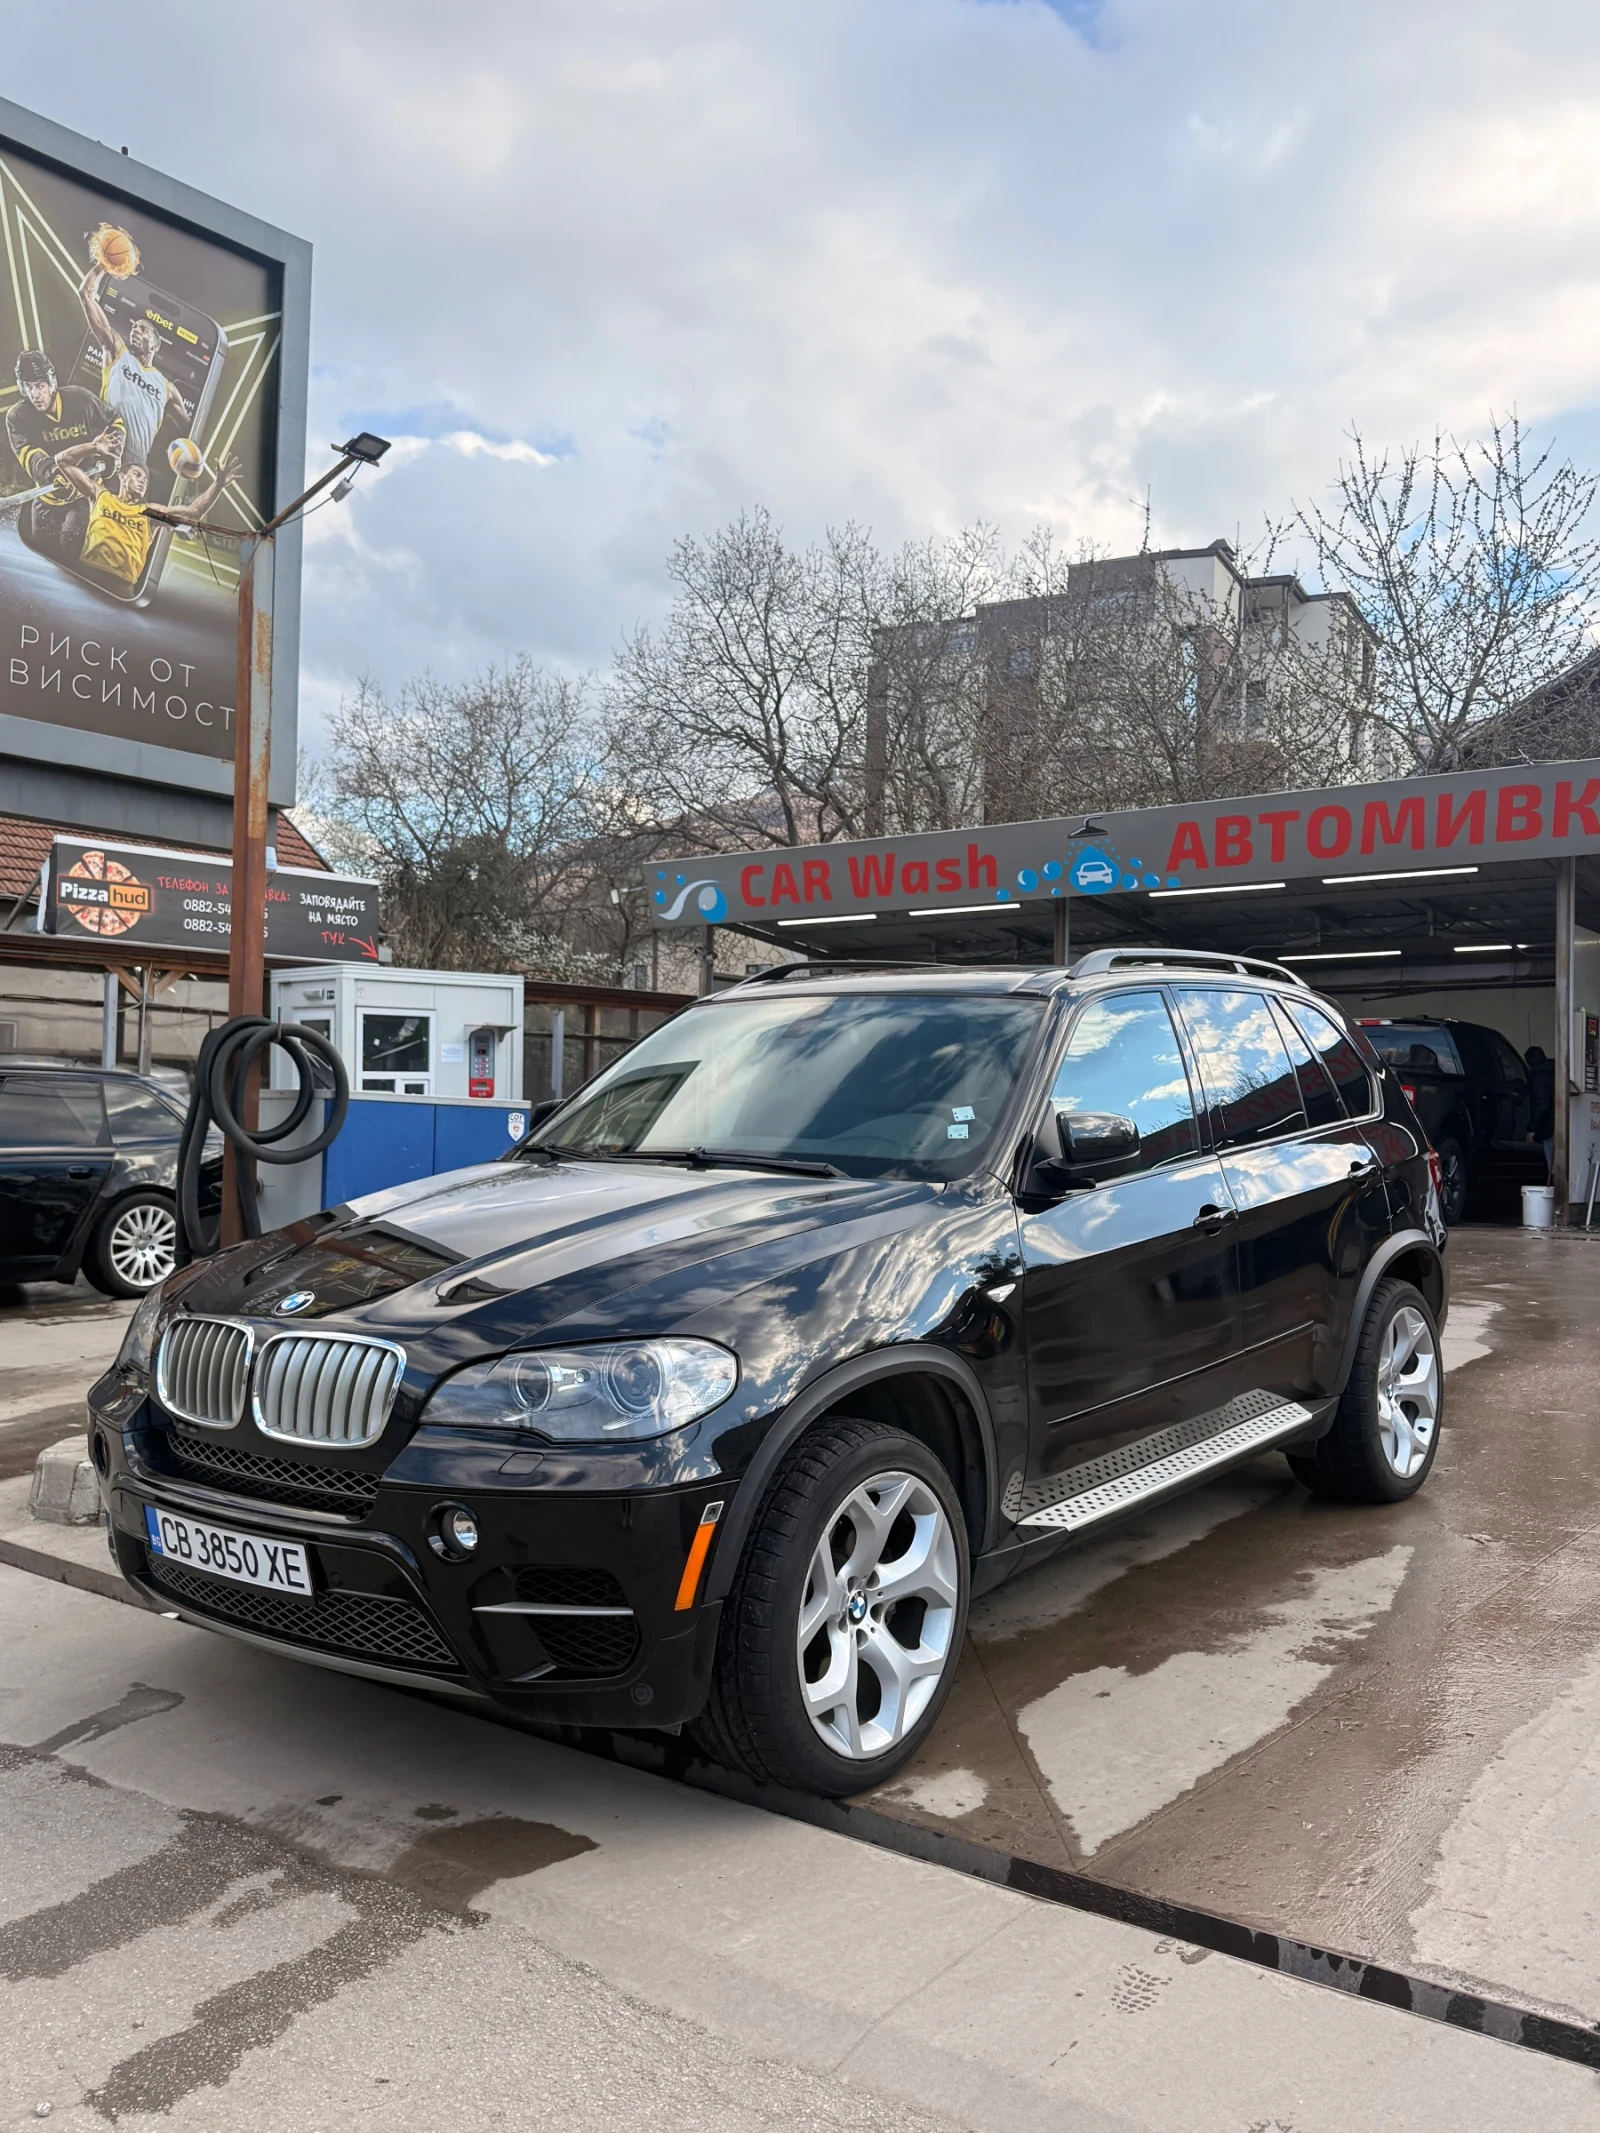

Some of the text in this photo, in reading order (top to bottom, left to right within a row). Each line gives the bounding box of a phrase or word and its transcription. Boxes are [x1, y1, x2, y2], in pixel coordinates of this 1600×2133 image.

[145, 308, 174, 331] efbet
[122, 365, 162, 401] efbet
[102, 504, 144, 532] efbet
[21, 624, 196, 688] РИСК ОТ
[10, 658, 236, 731] ВИСИМОСТ
[1165, 778, 1600, 872] АВТОМИВК
[157, 876, 209, 894] ТЕЛЕФОН
[216, 882, 229, 896] ЗА
[740, 843, 998, 907] CAR Wash
[60, 881, 146, 906] Pizza hud
[300, 892, 366, 912] ЗАПОВЯДАЙТЕ
[308, 911, 359, 927] НА МЯСТО
[321, 931, 345, 946] ТУК
[151, 1534, 162, 1548] BG
[161, 1516, 305, 1589] CB 3850 XE
